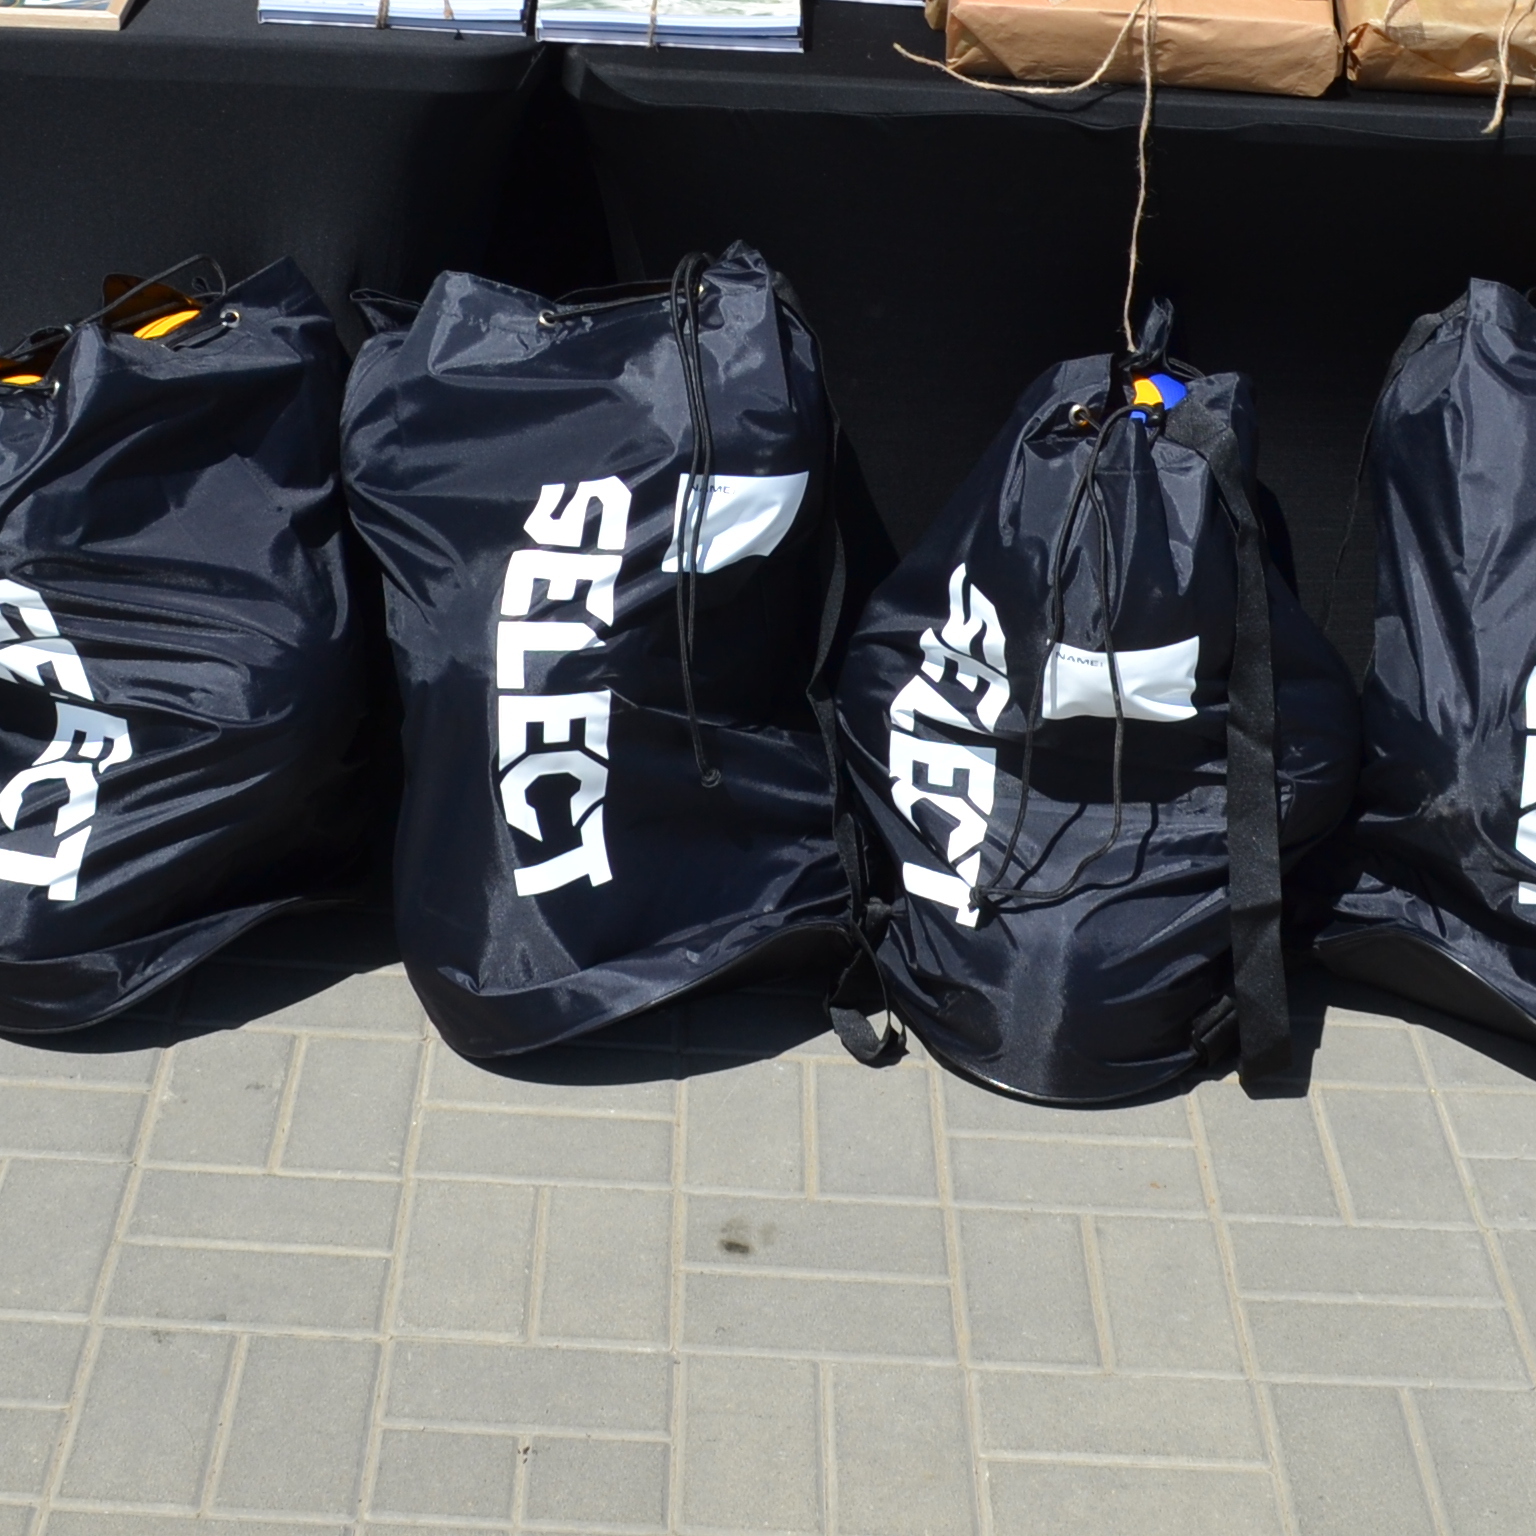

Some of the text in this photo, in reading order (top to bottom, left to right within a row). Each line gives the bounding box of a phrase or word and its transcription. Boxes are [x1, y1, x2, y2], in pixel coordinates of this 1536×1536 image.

[495, 475, 633, 898] SELECT
[889, 562, 1011, 929] SELECT
[1055, 650, 1104, 668] NAME:
